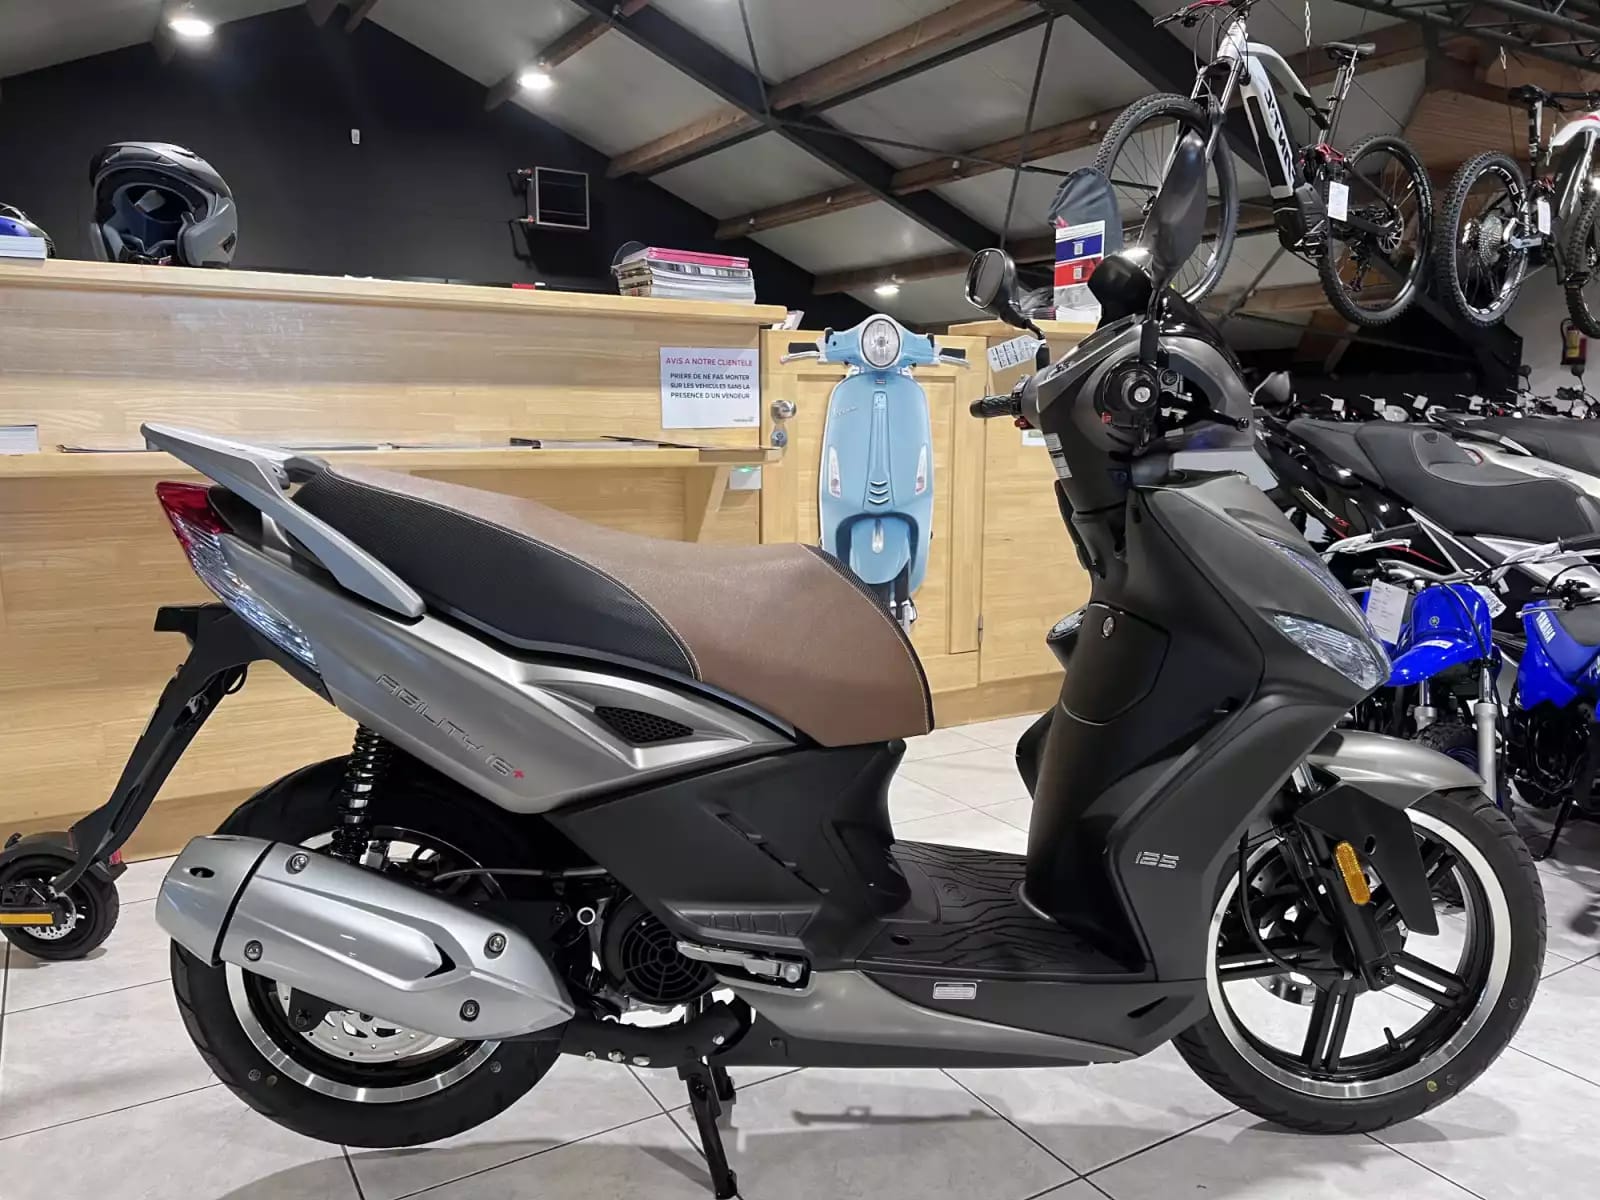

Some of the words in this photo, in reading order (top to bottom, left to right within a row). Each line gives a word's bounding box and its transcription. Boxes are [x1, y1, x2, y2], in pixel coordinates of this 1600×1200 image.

[666, 357, 684, 365] AVIS
[685, 357, 691, 365] A
[692, 358, 717, 366] NOTRE
[670, 372, 691, 380] PRIERE
[1536, 611, 1556, 645] YAMAHA
[376, 673, 484, 752] AGILITY
[1135, 851, 1180, 869] 125
